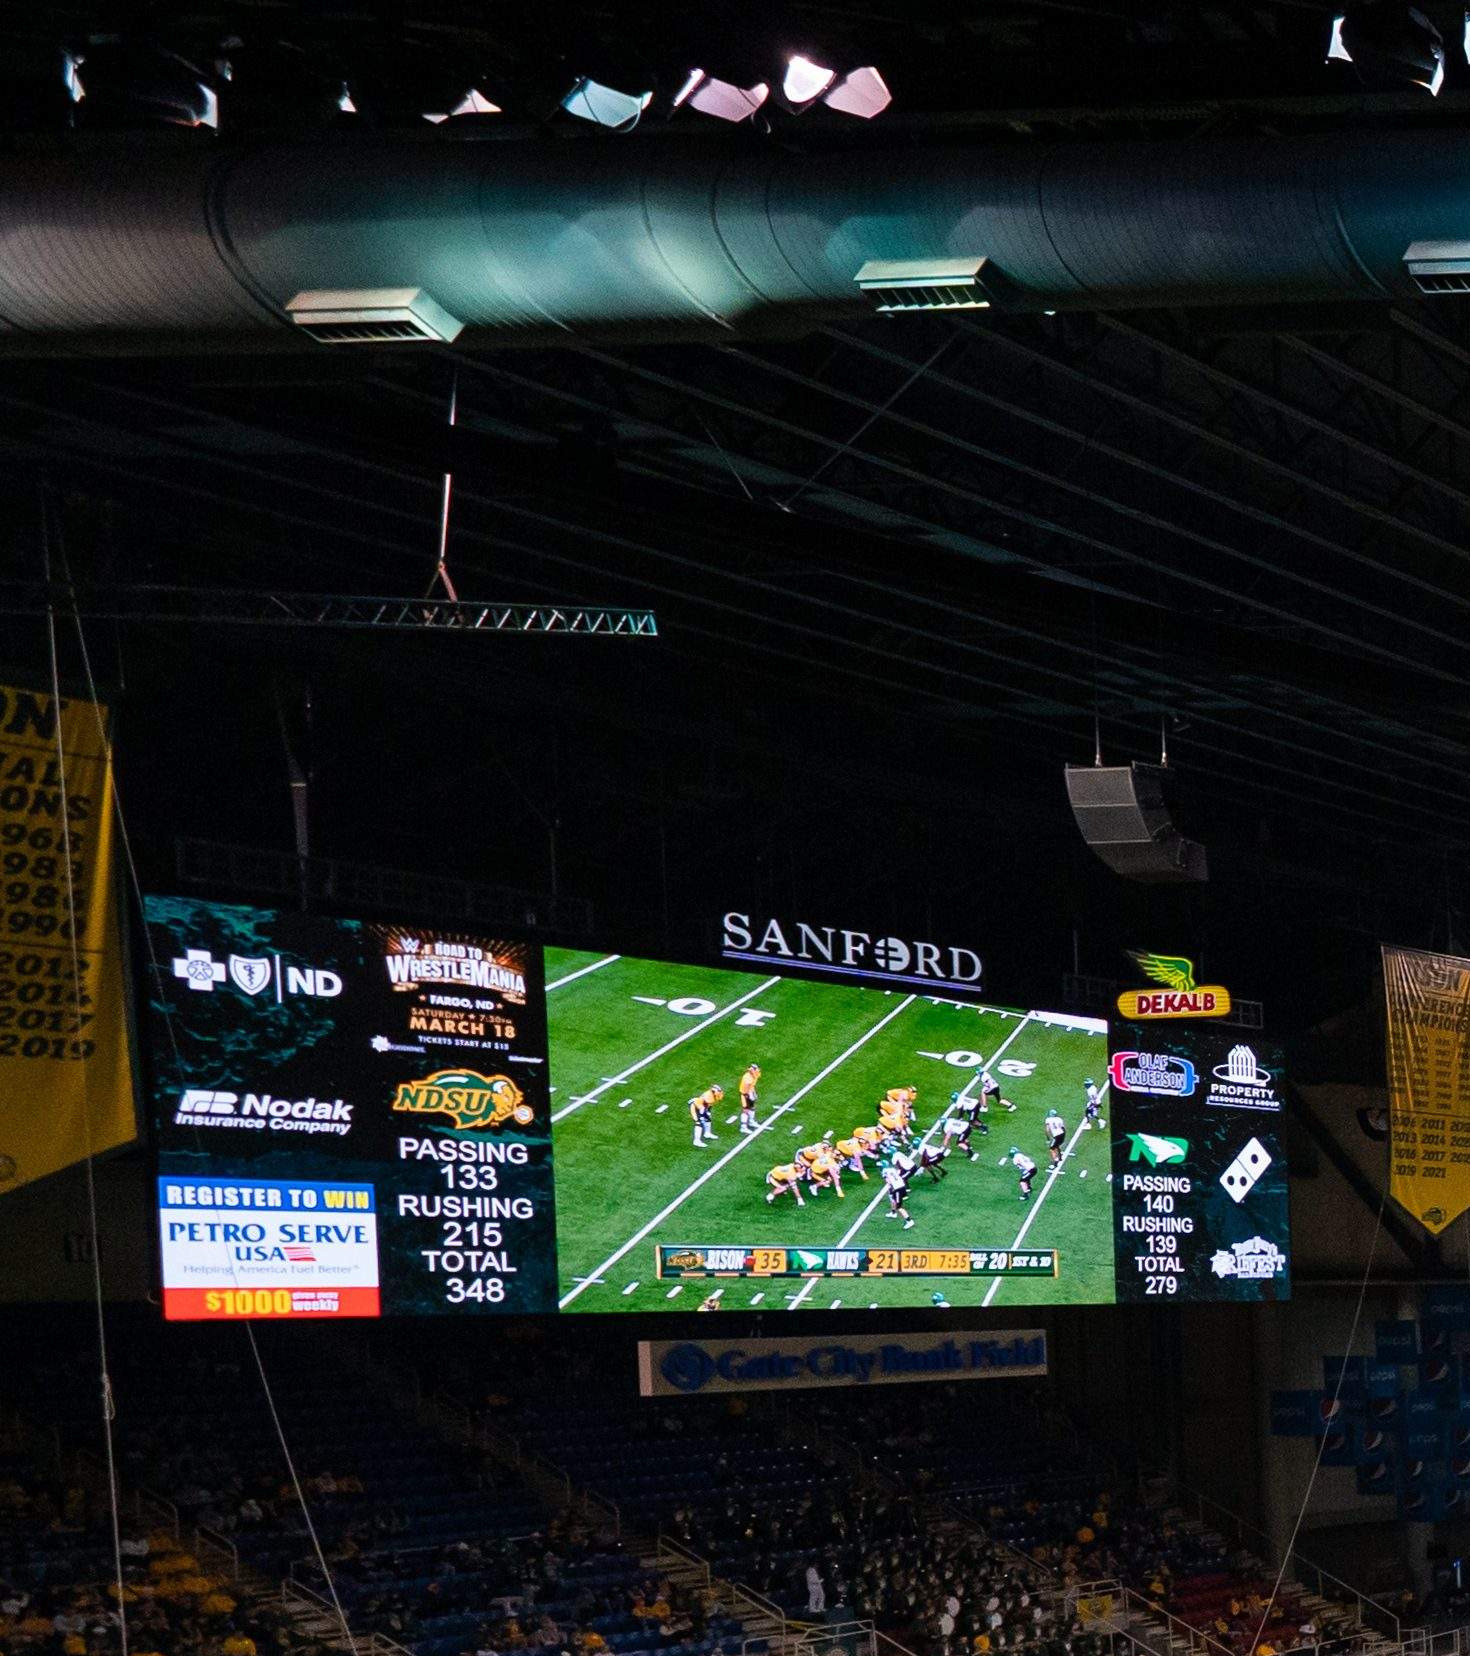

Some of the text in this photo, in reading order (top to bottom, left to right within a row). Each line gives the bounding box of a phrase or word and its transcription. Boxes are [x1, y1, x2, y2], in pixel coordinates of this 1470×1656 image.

[722, 911, 983, 983] SANFORD
[287, 966, 343, 997] ND
[1136, 992, 1216, 1015] DEKALB
[409, 1016, 517, 1039] MARCH 18
[1138, 1052, 1169, 1070] OLAF
[1124, 1066, 1186, 1088] ANDERSON
[395, 1084, 489, 1116] NDSU
[1210, 1083, 1275, 1099] PROPERTY
[242, 1093, 354, 1121] Nodak
[175, 1112, 351, 1136] Insurance Company
[398, 1136, 529, 1165] PASSING
[440, 1163, 498, 1190] 133
[1123, 1174, 1191, 1194] PASSING
[166, 1184, 370, 1209] REGISTER TO WIN
[398, 1194, 534, 1220] RUSHING
[1143, 1194, 1174, 1214] 140
[169, 1222, 370, 1244] PETRO SERVE
[443, 1221, 503, 1247] 215
[1122, 1215, 1194, 1234] RUSHING
[235, 1246, 287, 1261] USA
[1145, 1235, 1177, 1254] 139
[421, 1250, 518, 1273] TOTAL
[704, 1249, 969, 1271] BISON 35 21 3RD 7:35
[988, 1252, 1008, 1270] 20
[1135, 1255, 1185, 1273] TOTAL
[446, 1277, 505, 1303] 348
[1145, 1275, 1177, 1295] 279
[206, 1289, 292, 1315] $1000
